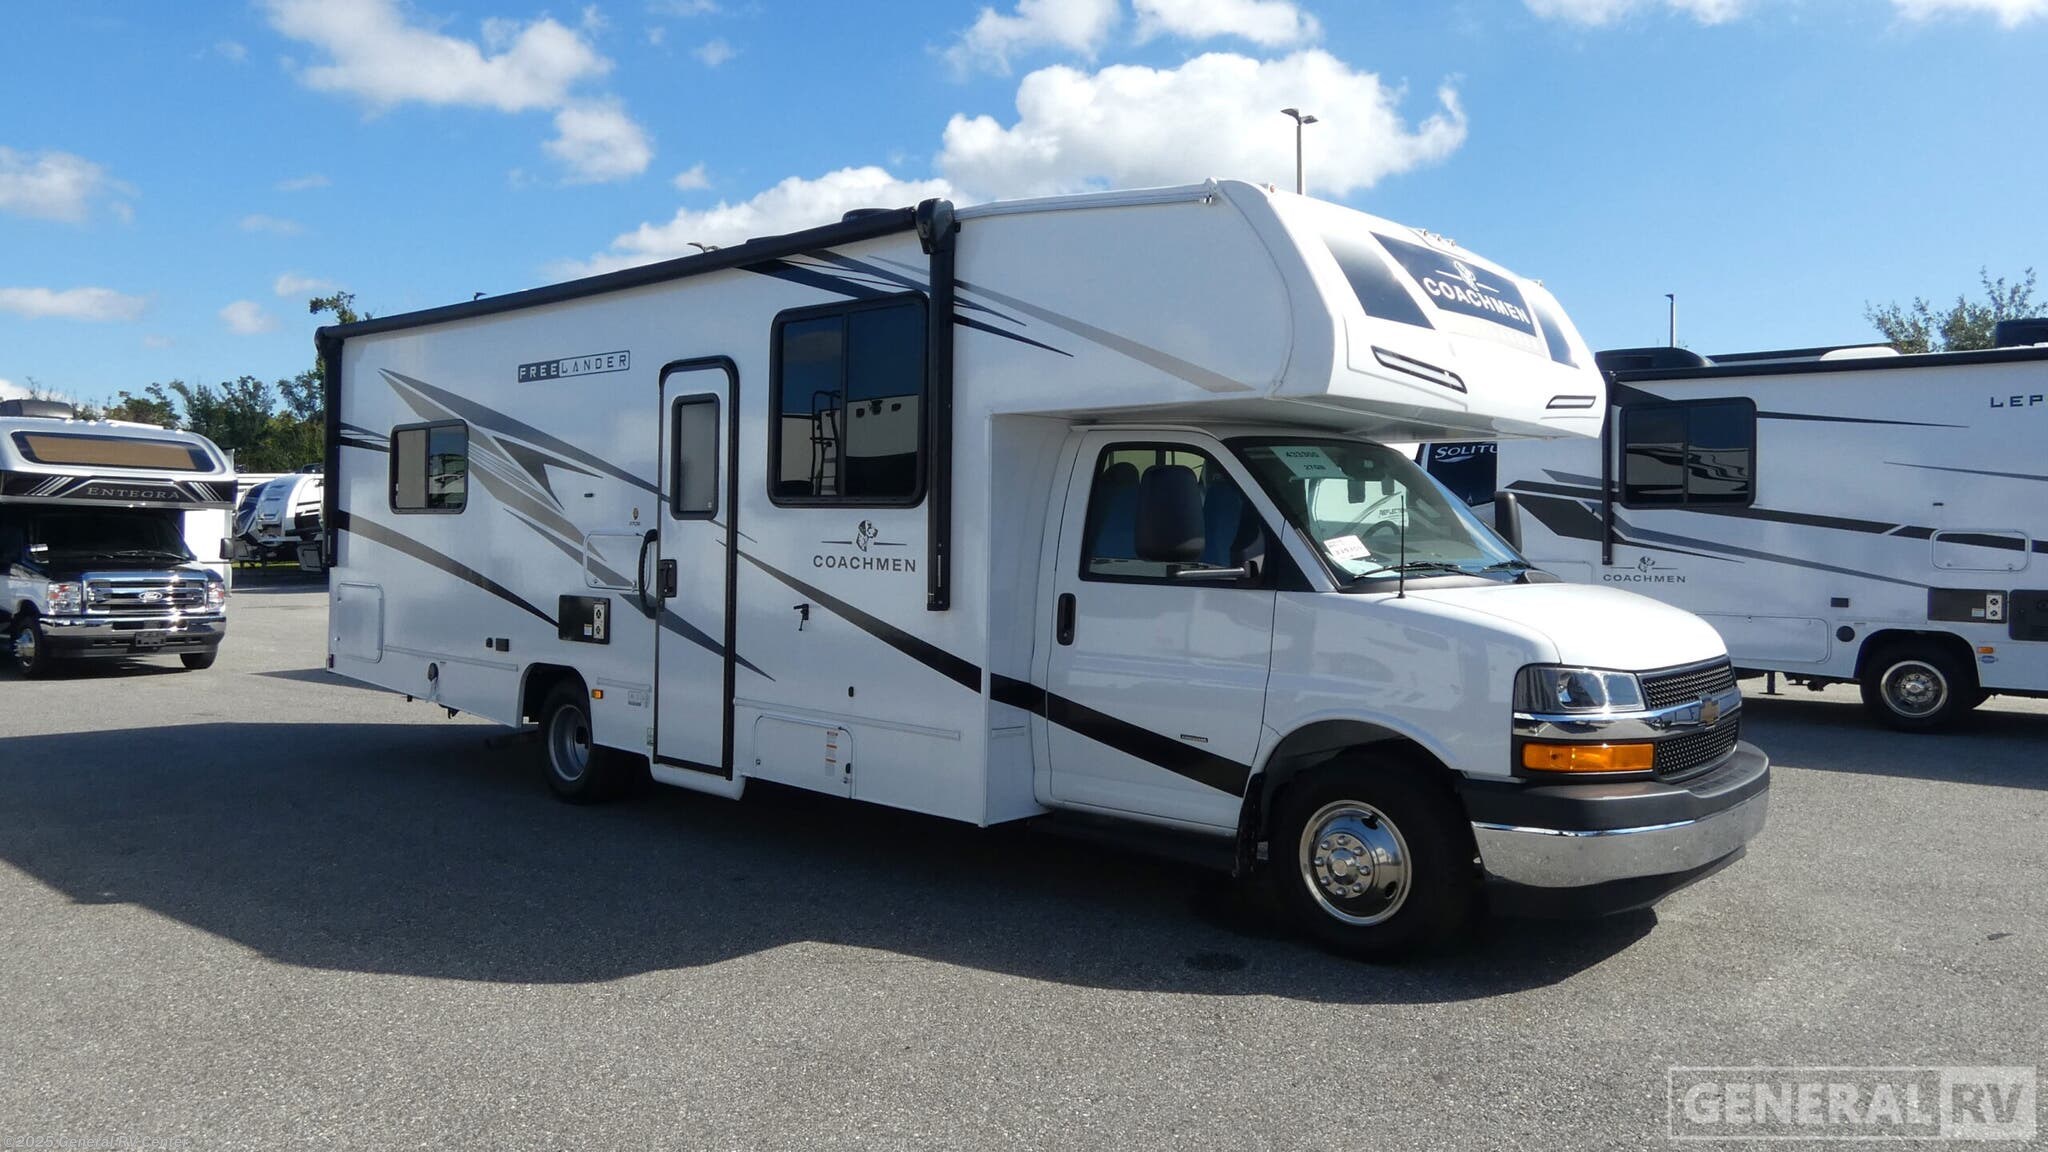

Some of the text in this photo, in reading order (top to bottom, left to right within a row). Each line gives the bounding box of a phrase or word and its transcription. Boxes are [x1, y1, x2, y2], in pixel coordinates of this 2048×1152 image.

[1422, 277, 1530, 325] COACHMEN
[519, 354, 627, 380] FREELANDER
[87, 486, 180, 499] ENTEGRA
[813, 555, 916, 572] COACHMEN
[1602, 573, 1686, 583] COACHMEN
